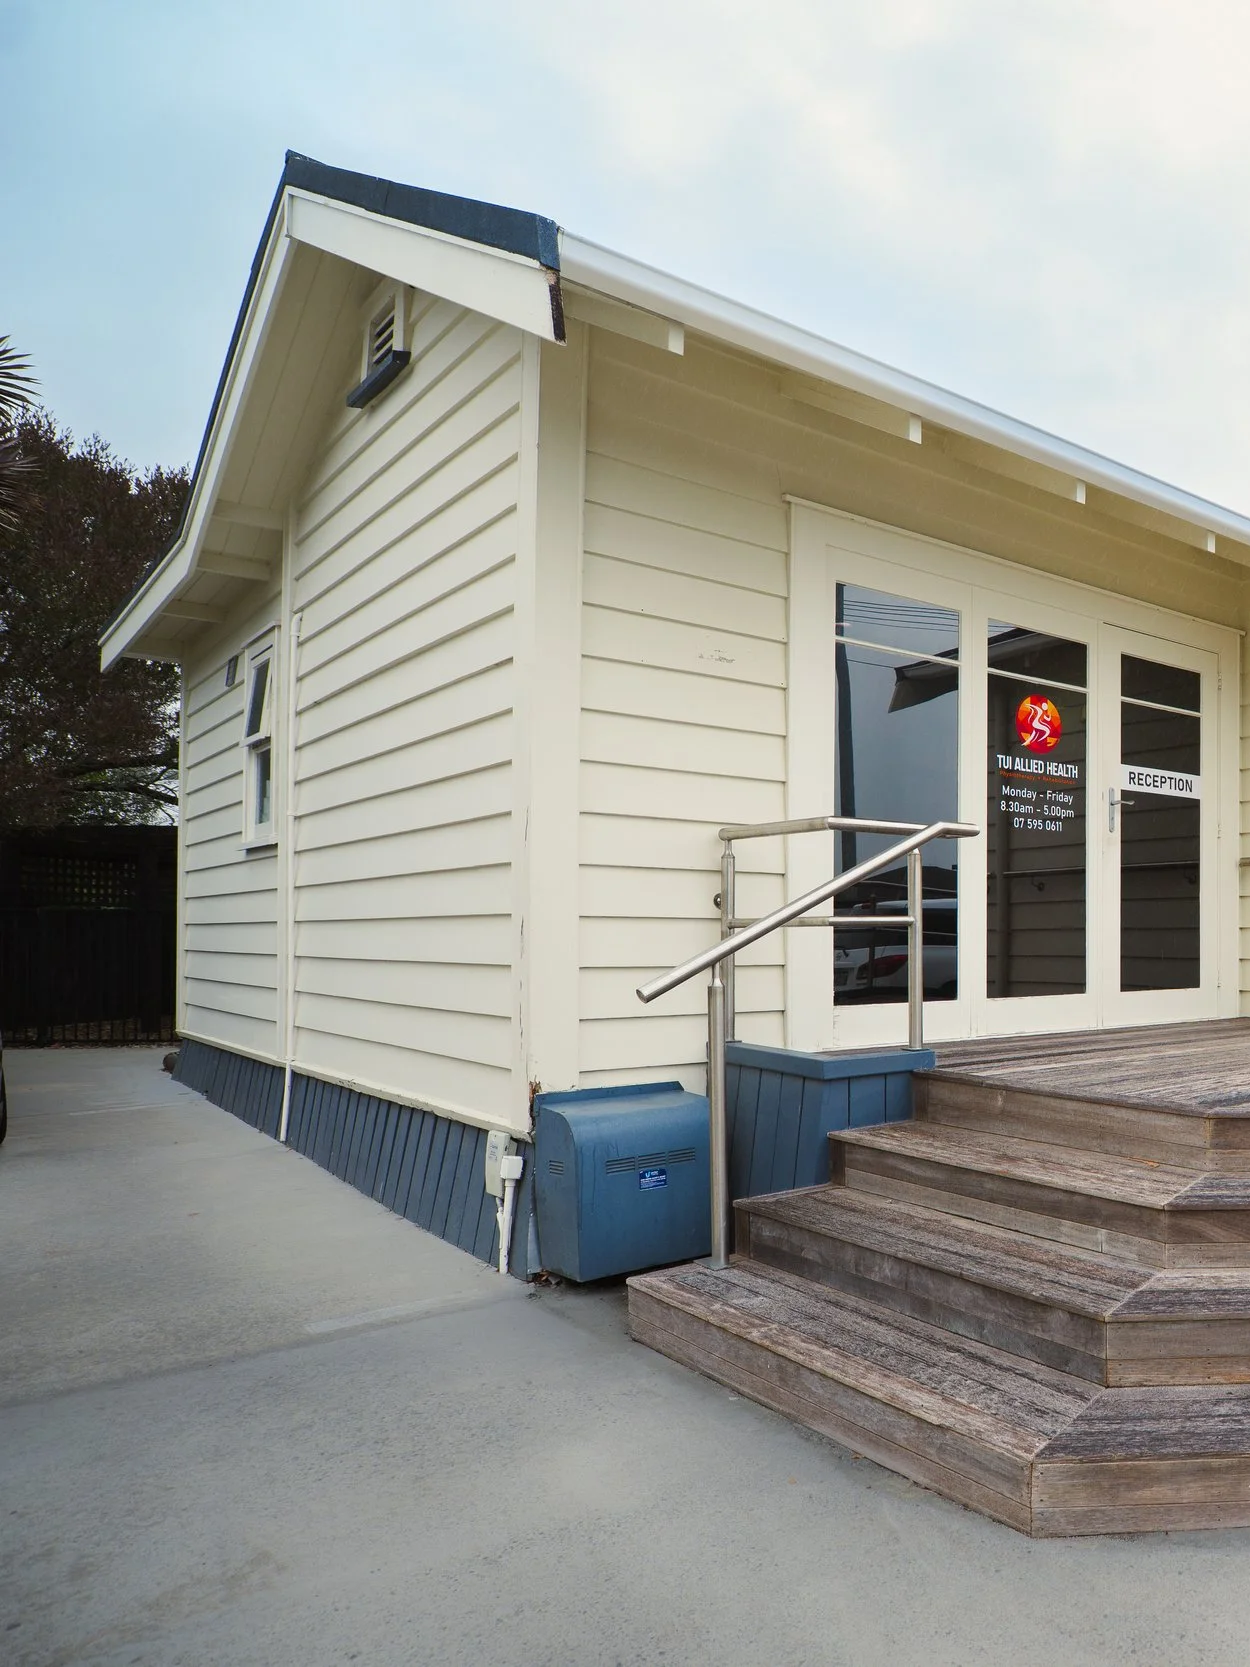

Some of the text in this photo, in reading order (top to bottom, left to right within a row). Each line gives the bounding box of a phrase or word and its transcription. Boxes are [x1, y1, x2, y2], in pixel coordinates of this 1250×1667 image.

[997, 754, 1078, 778] TUI ALLIED HEALTH
[1128, 771, 1193, 793] RECEPTION
[1002, 785, 1037, 801] Monday
[1046, 790, 1073, 805] Friday
[1000, 800, 1034, 814] 8.30am
[1043, 805, 1075, 819] 5.00pm
[1013, 817, 1062, 832] 07 595 0611
